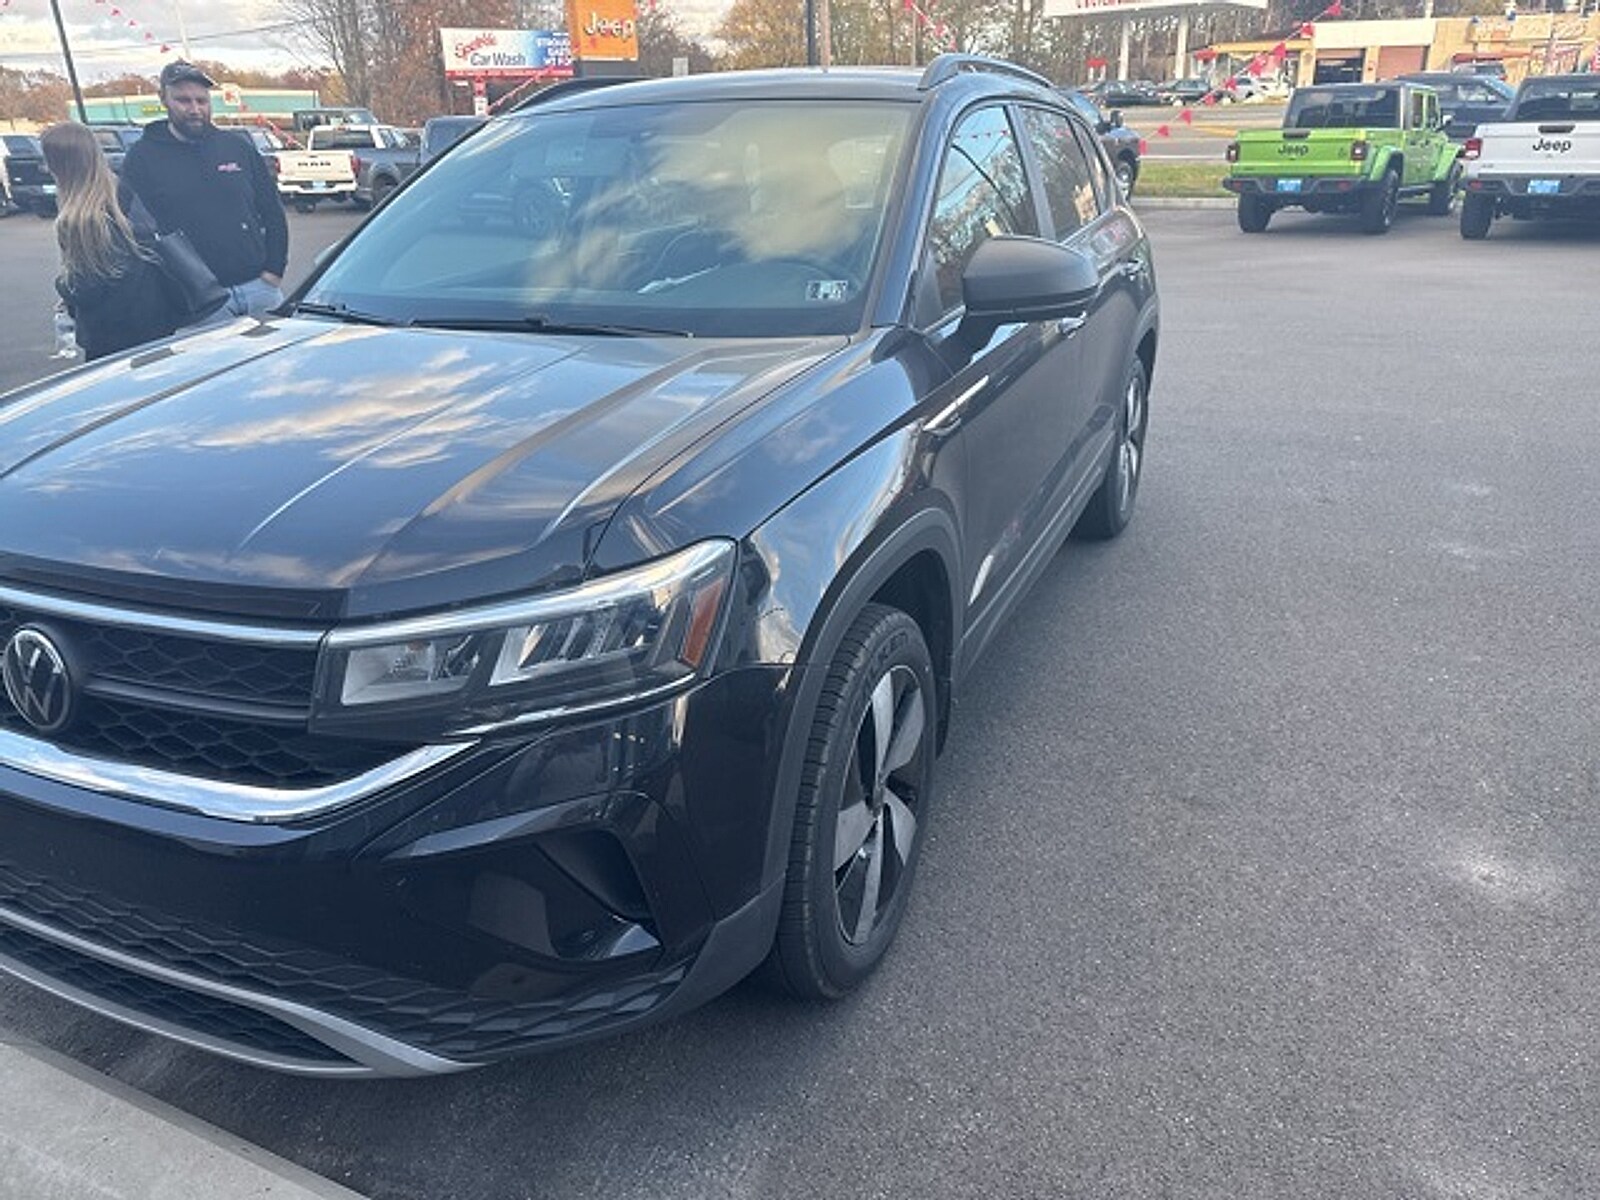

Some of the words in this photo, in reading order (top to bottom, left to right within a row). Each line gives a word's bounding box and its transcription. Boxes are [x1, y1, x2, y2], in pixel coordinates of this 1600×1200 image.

[585, 12, 633, 40] Jeep
[470, 53, 491, 66] Car
[493, 53, 526, 66] Wash
[1278, 144, 1309, 157] Jeep
[1532, 138, 1572, 154] Jeep
